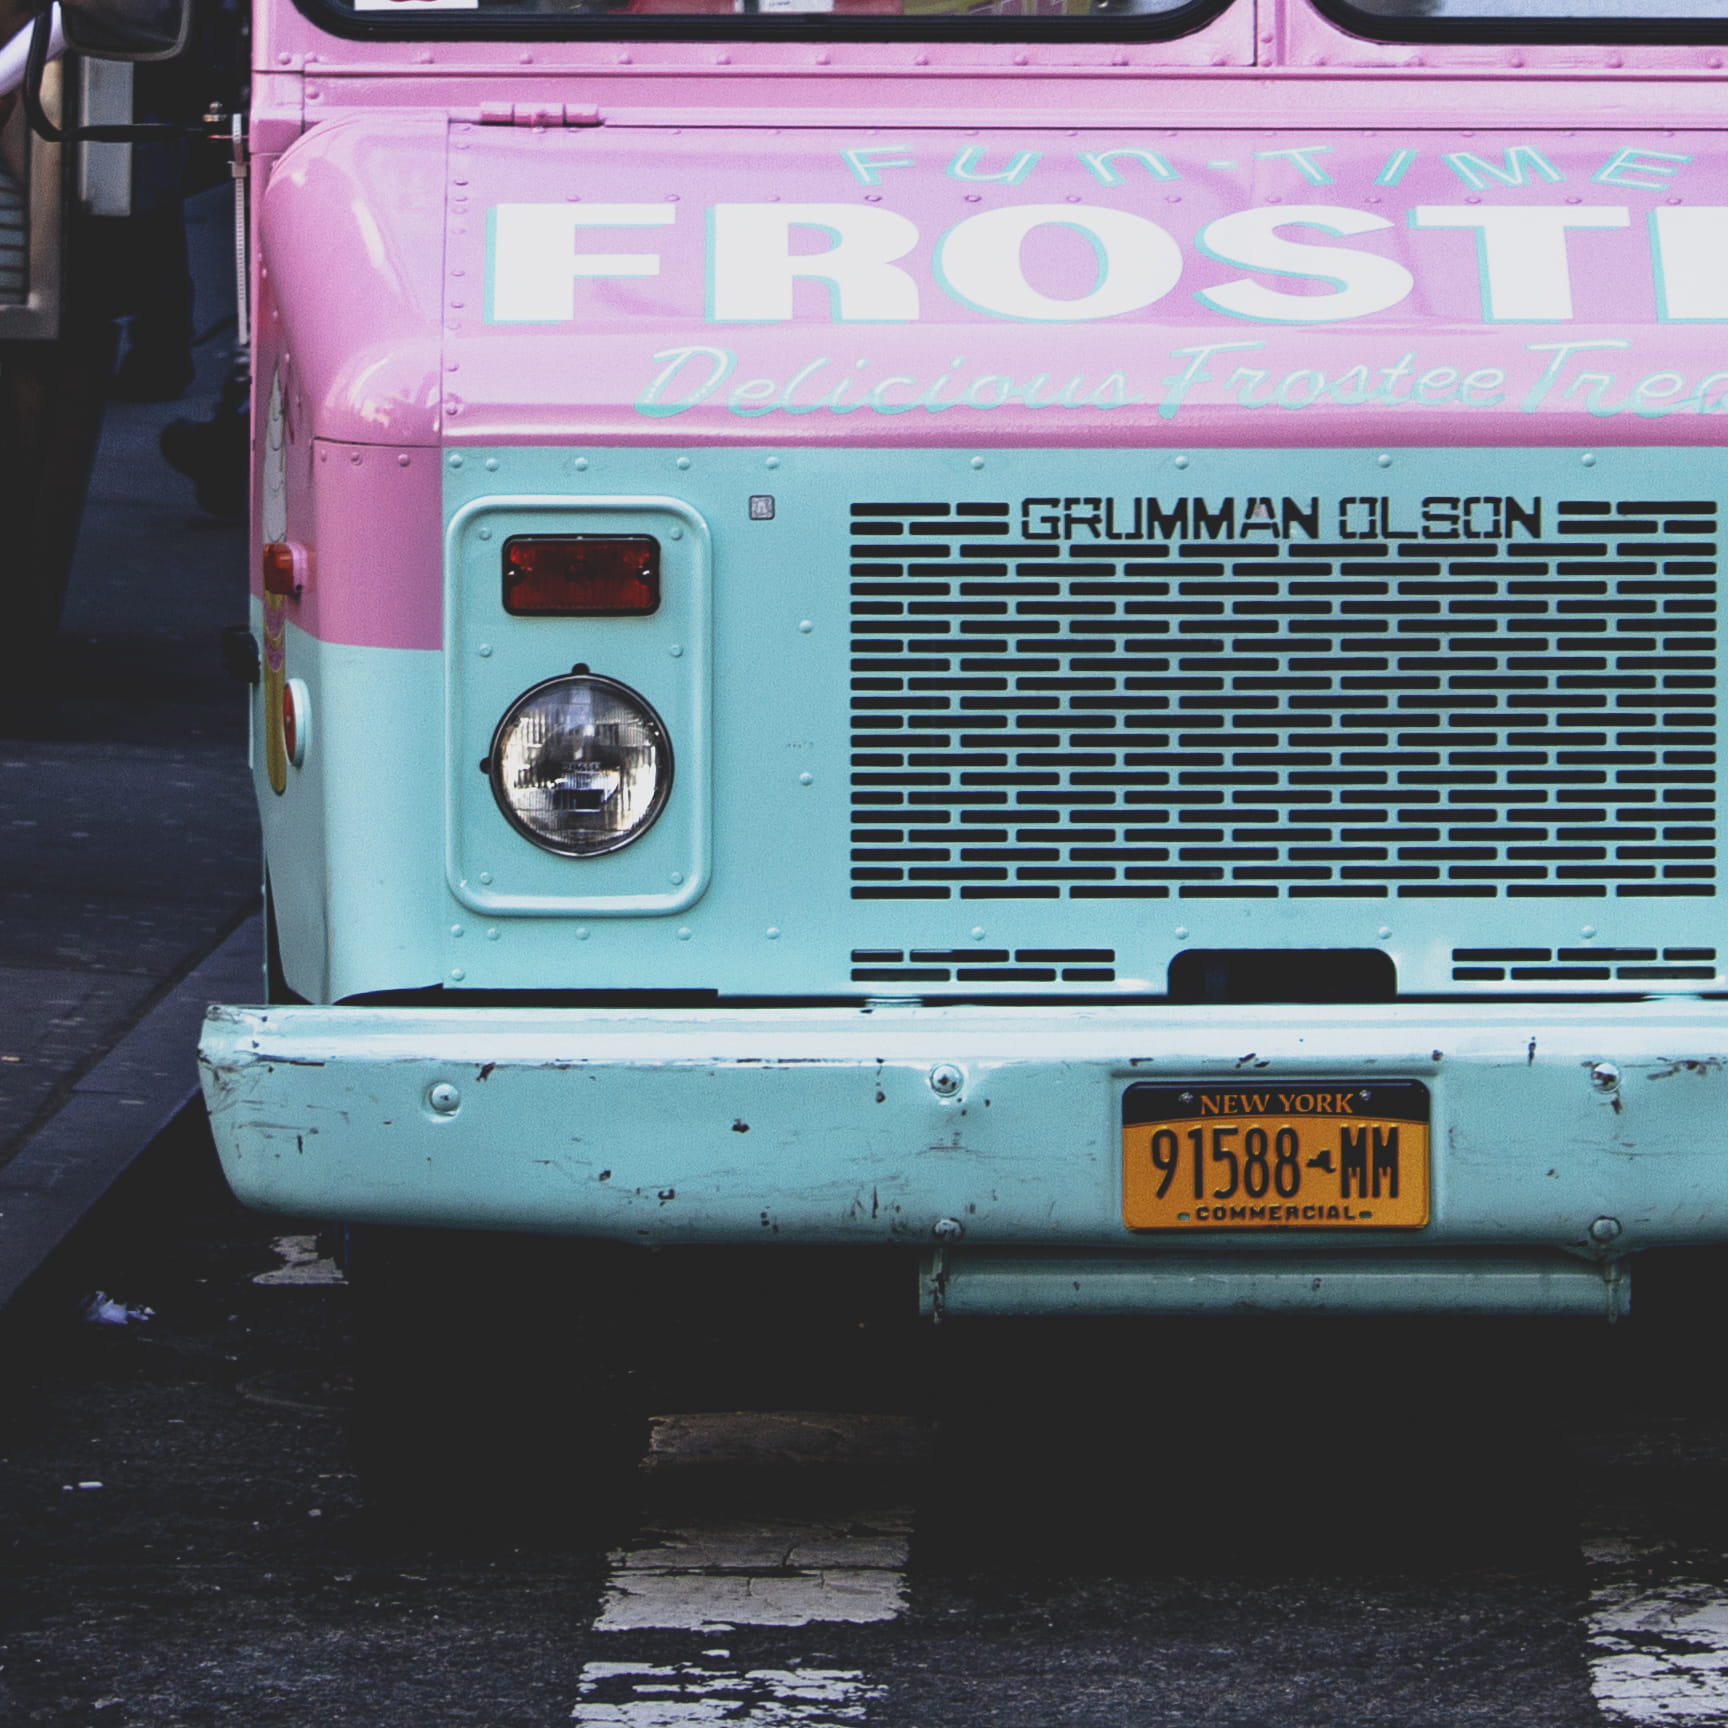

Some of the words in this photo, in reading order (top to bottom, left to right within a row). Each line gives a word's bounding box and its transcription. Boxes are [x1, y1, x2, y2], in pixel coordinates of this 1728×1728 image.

[633, 342, 1148, 420] Delicious
[1154, 338, 1508, 422] Frostee
[1021, 496, 1320, 541] GRUMMAN
[1338, 496, 1542, 541] OLSON
[1200, 1094, 1271, 1116] NEW
[1277, 1093, 1355, 1114] YORK
[1195, 1204, 1356, 1222] COMMERCIAL
